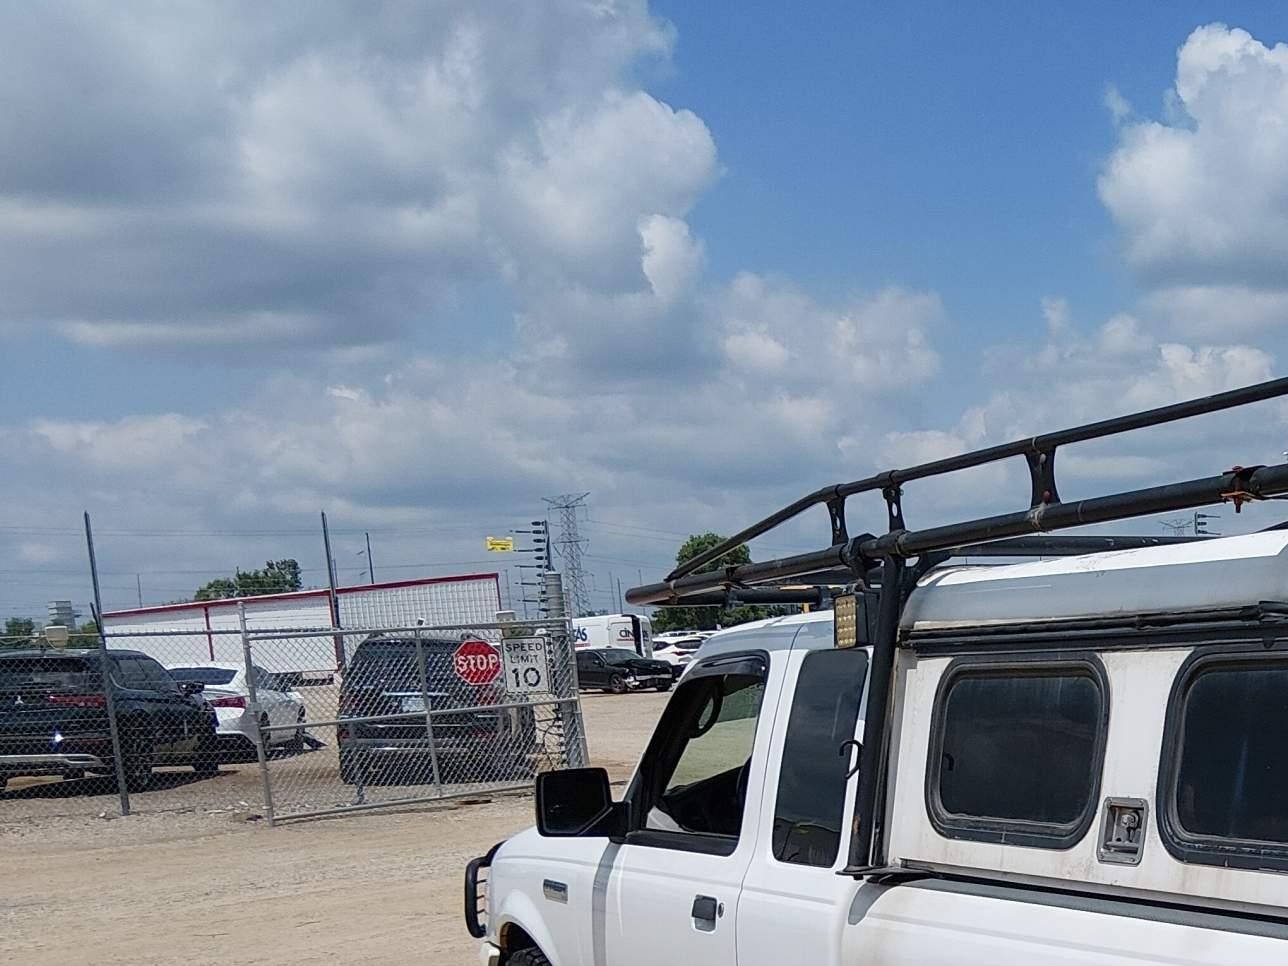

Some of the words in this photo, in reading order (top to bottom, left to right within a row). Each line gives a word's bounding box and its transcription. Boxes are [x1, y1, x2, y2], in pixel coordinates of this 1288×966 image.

[505, 642, 543, 652] SPEED
[455, 654, 499, 672] STOP
[510, 654, 540, 664] LIMIT
[511, 667, 541, 688] 10
